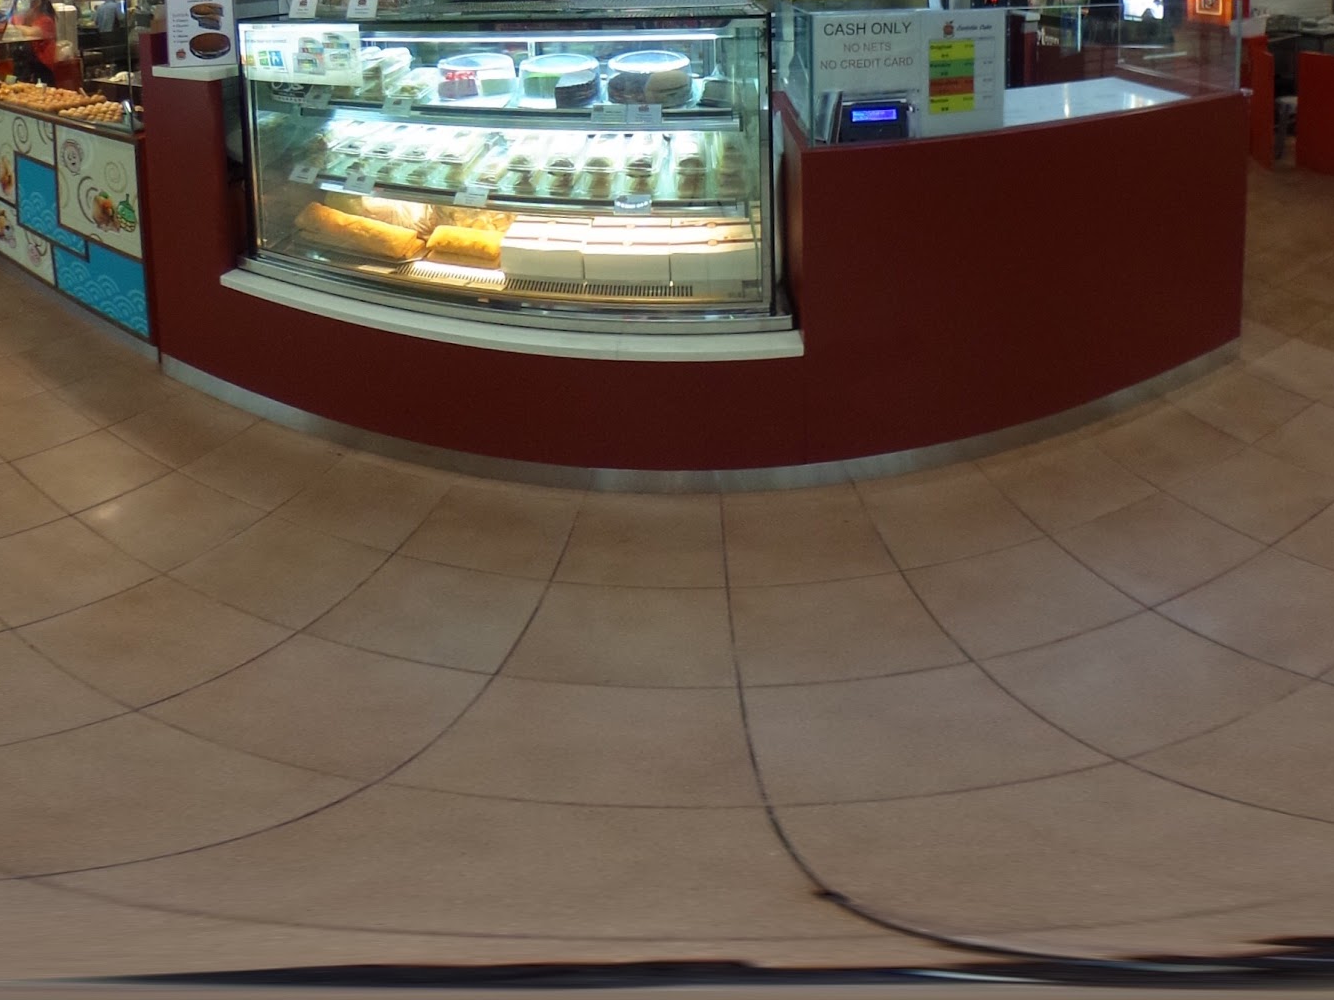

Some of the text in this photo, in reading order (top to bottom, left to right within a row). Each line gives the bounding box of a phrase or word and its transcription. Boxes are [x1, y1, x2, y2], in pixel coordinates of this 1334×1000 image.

[823, 22, 912, 36] CASH ONLY
[843, 42, 891, 52] NO NETS
[820, 57, 913, 70] NO CREDIT CARD
